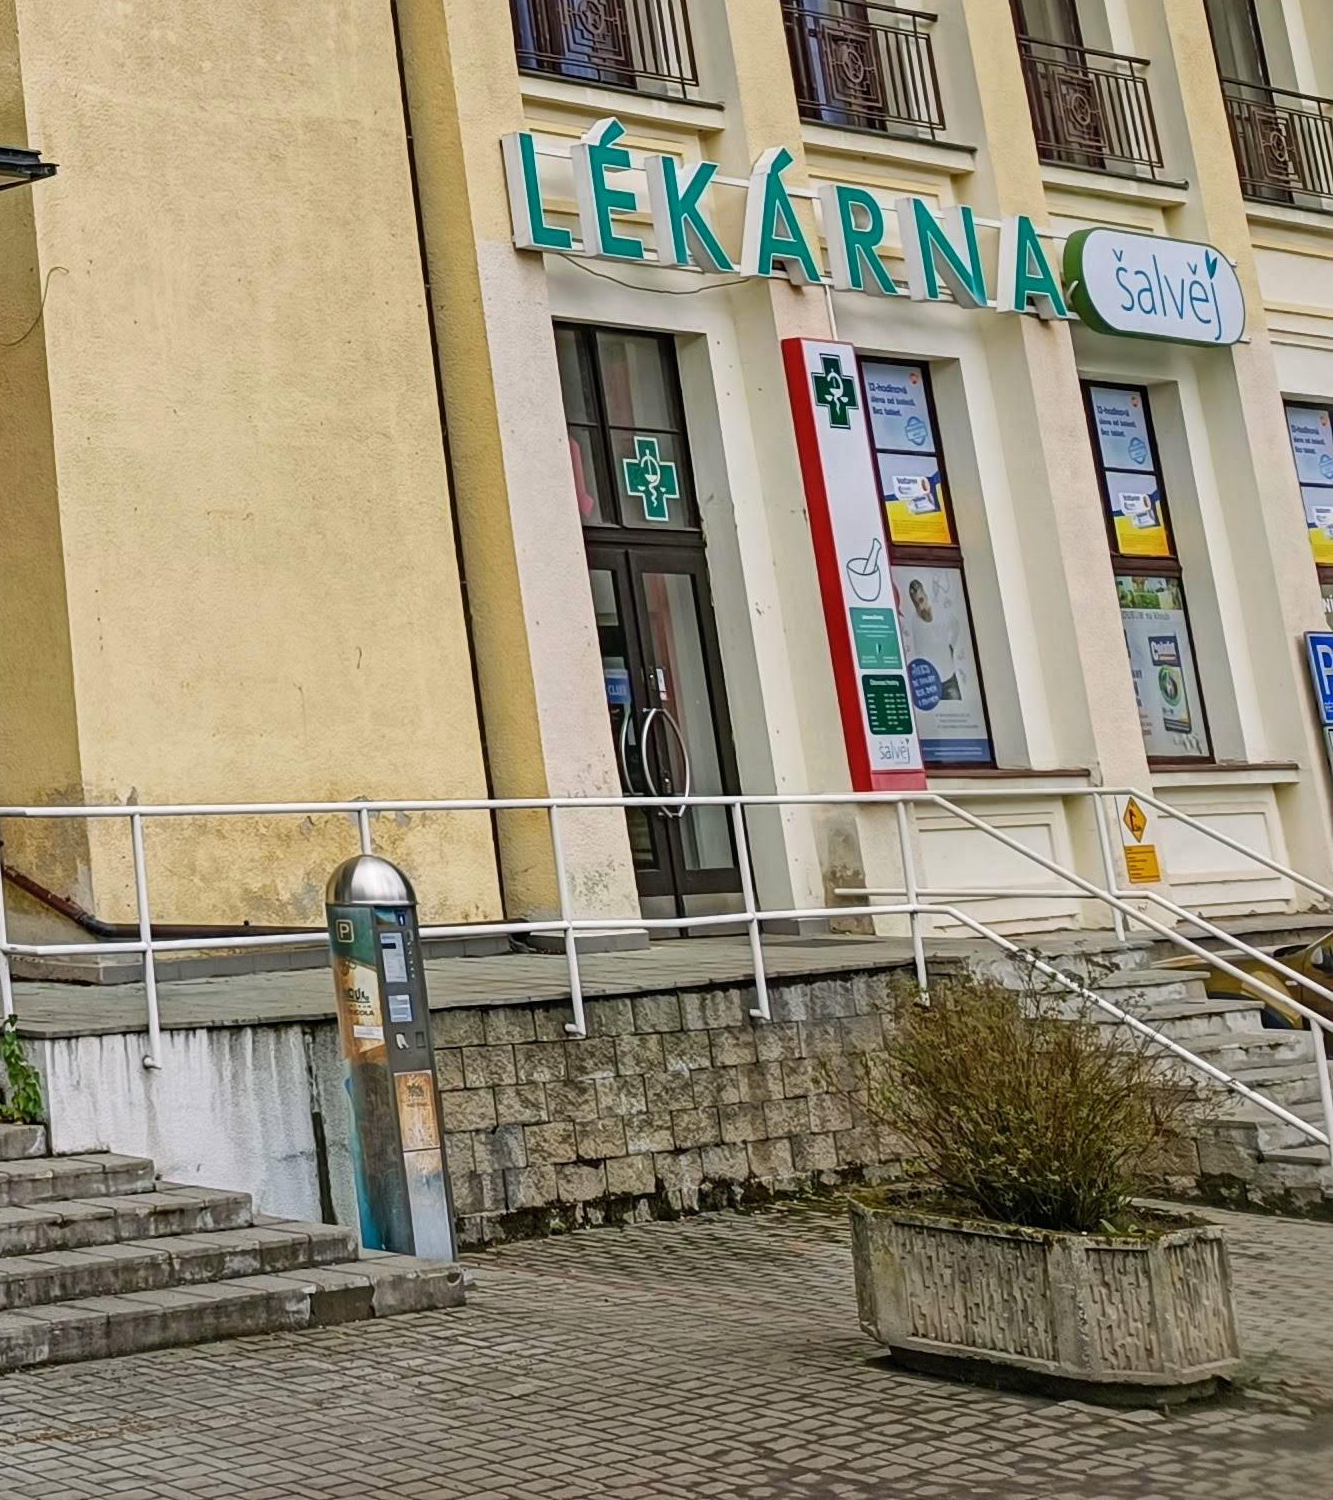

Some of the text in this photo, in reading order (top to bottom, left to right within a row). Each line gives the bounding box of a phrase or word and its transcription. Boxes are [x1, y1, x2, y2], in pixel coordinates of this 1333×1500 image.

[508, 117, 1071, 320] LÉKÁRNA
[1113, 249, 1222, 341] šalvěj
[339, 923, 350, 939] P
